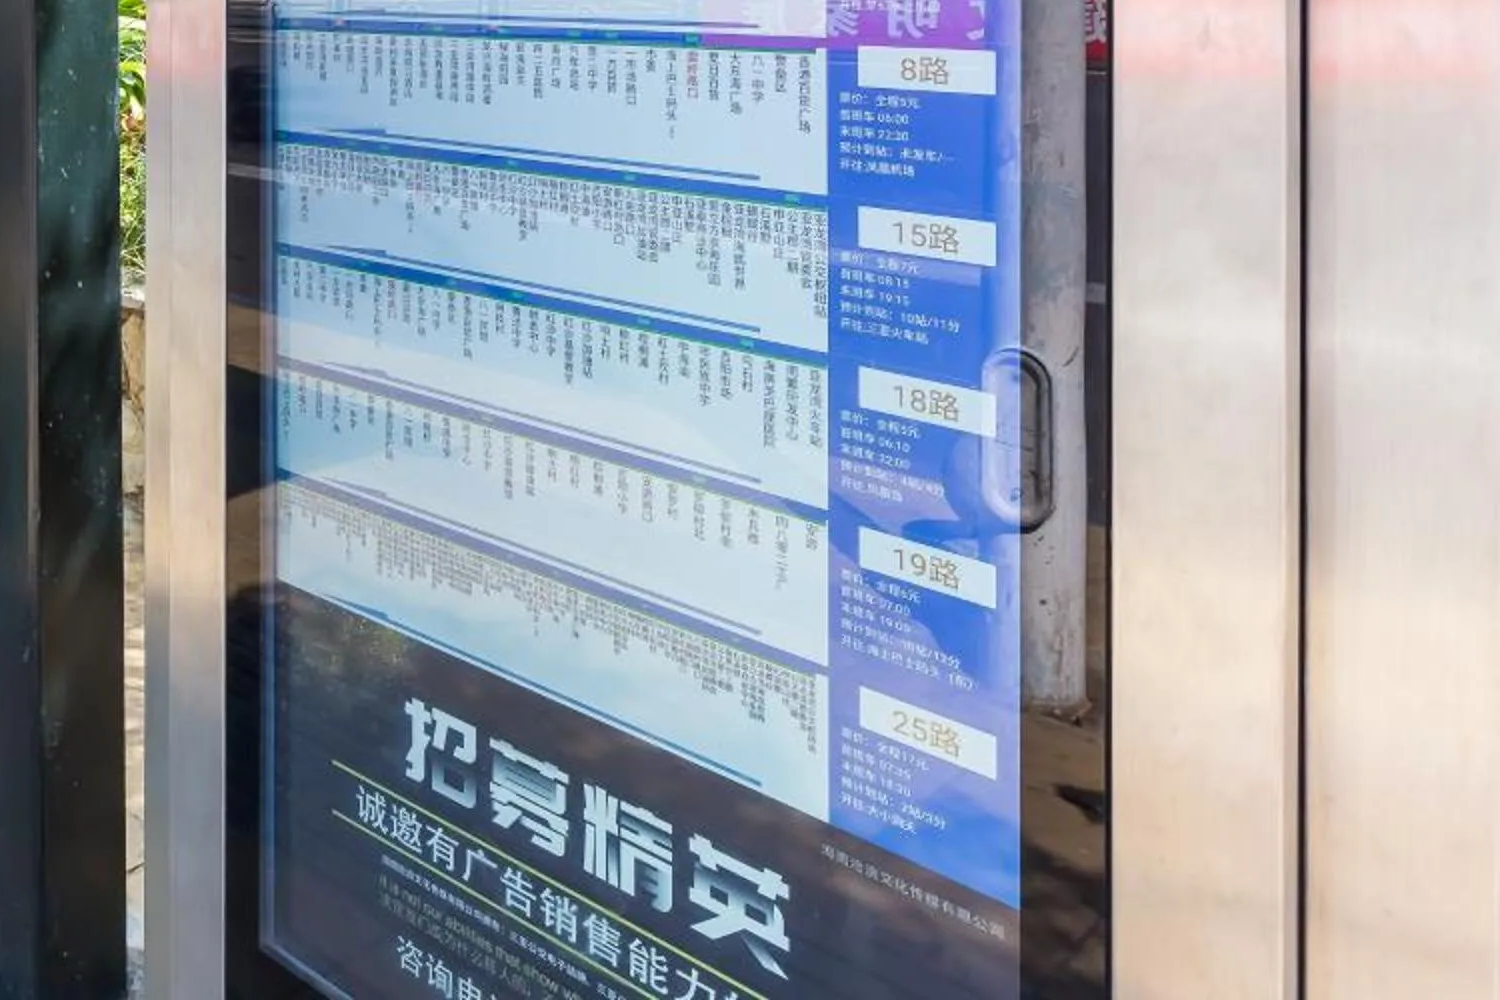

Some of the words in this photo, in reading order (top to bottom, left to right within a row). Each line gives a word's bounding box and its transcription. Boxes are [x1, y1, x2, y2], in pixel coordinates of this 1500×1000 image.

[900, 57, 949, 85] 8路
[892, 222, 959, 253] 15路
[894, 385, 959, 422] 18路
[894, 549, 959, 590] 19路
[892, 711, 959, 758] 25路
[404, 697, 790, 980] 招募精英
[397, 936, 499, 1000] 咨询电
